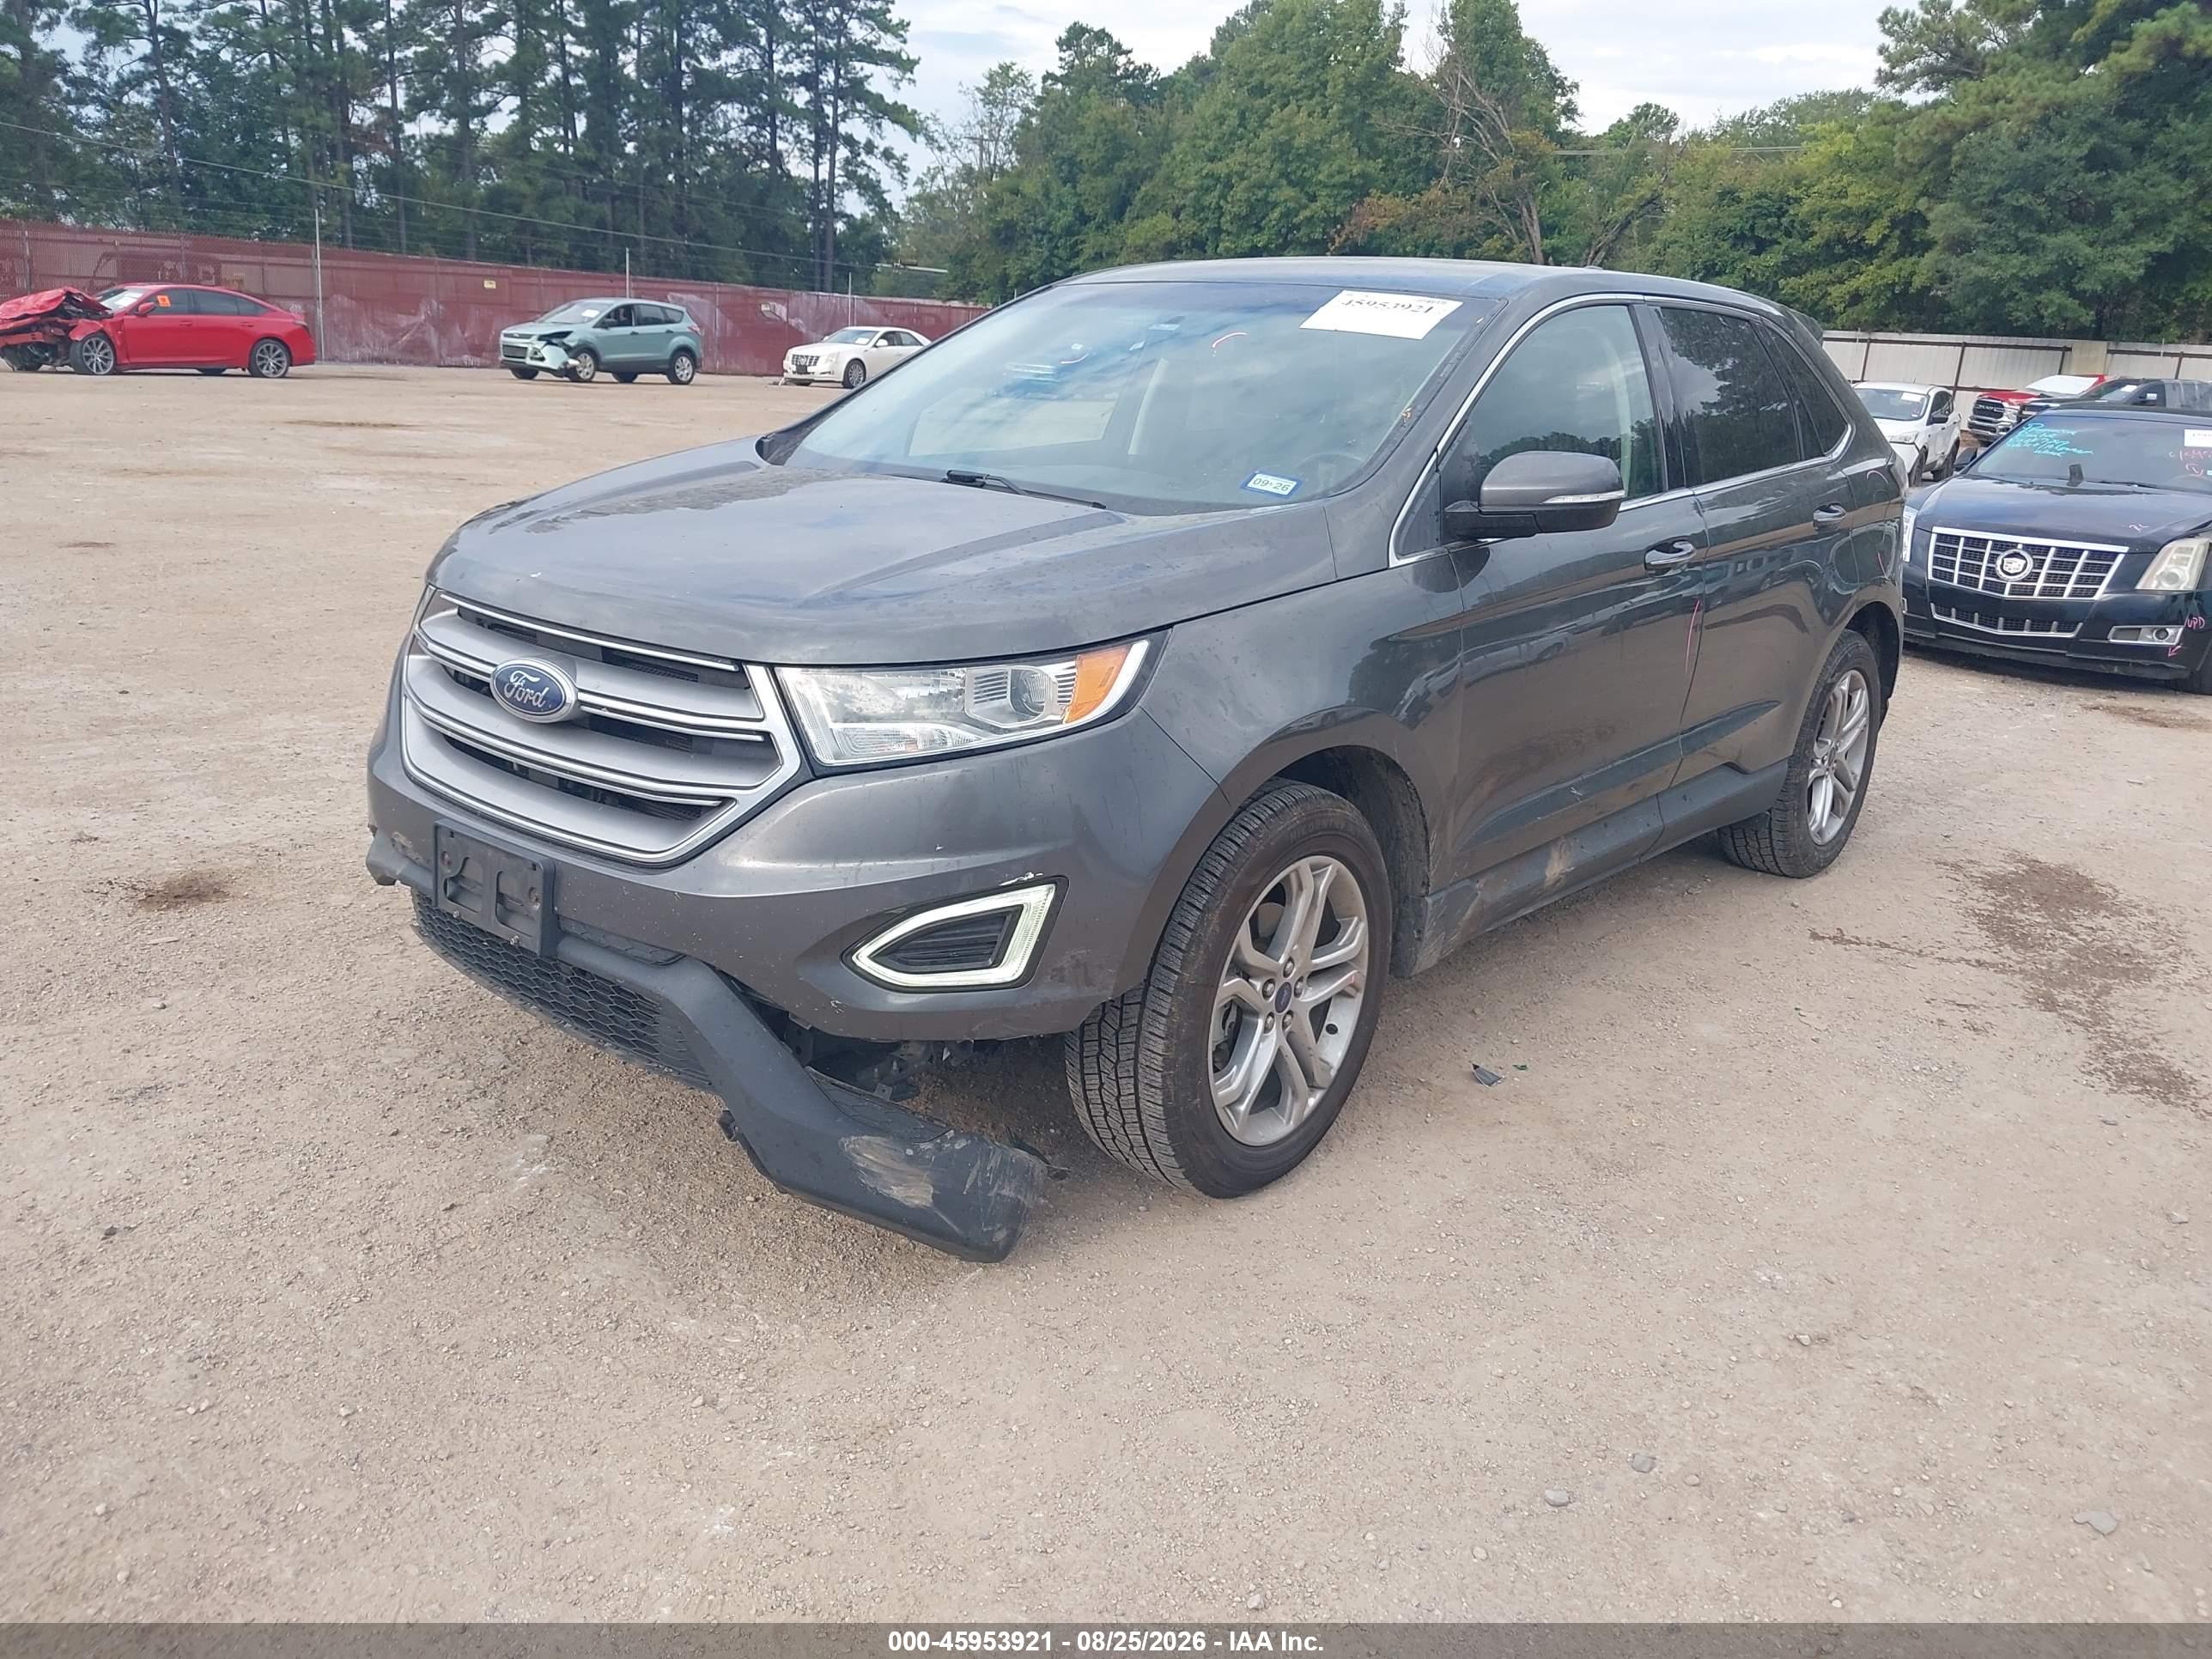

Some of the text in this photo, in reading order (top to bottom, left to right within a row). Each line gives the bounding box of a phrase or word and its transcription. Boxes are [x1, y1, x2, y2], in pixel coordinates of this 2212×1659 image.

[1252, 477, 1291, 492] 09 26
[503, 670, 550, 708] Ford
